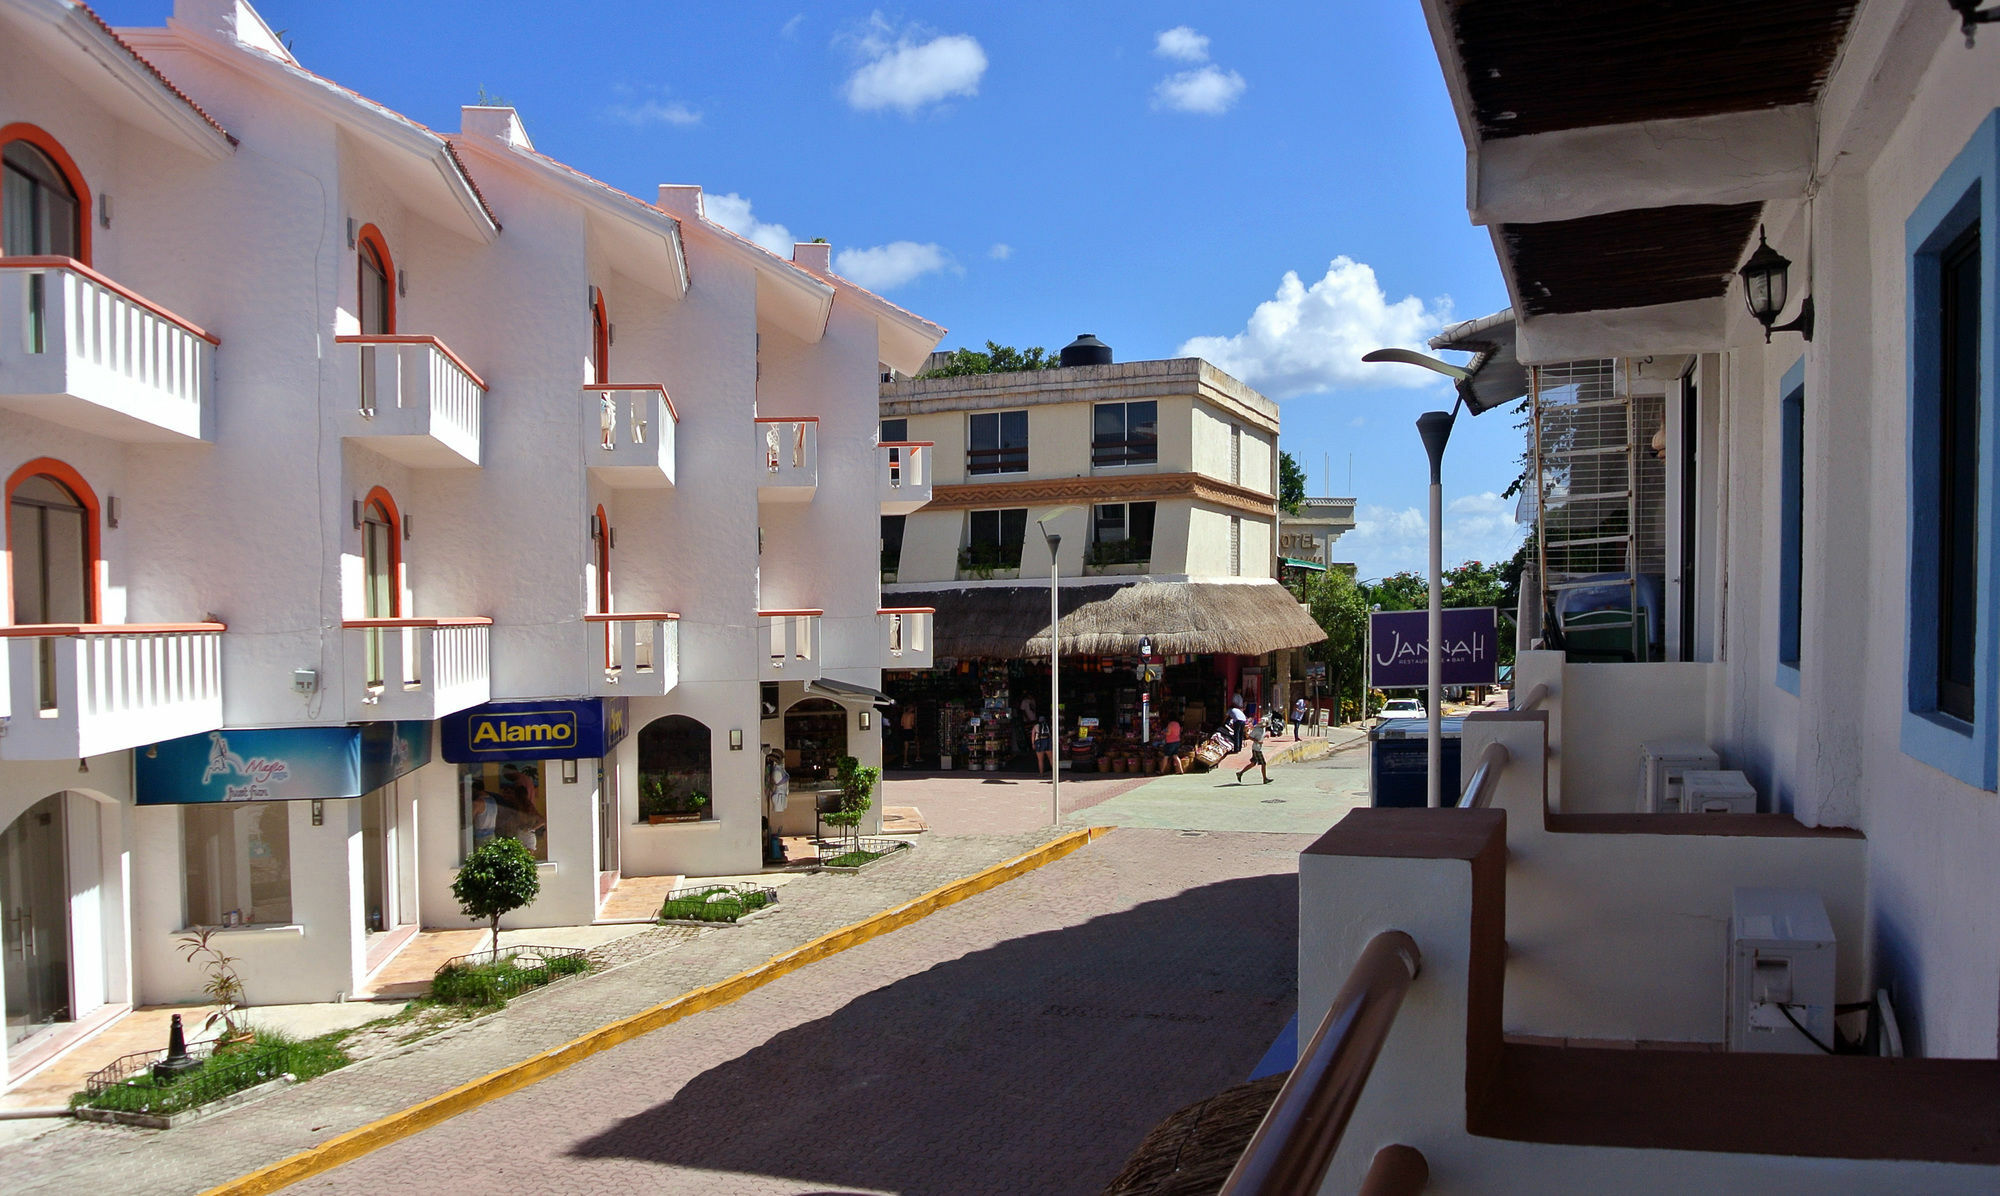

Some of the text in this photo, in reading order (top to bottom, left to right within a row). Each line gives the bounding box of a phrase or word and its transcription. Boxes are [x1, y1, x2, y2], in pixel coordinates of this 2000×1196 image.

[1280, 534, 1320, 549] OTEL
[1398, 657, 1444, 665] RESTAURE
[473, 720, 572, 743] Alamo
